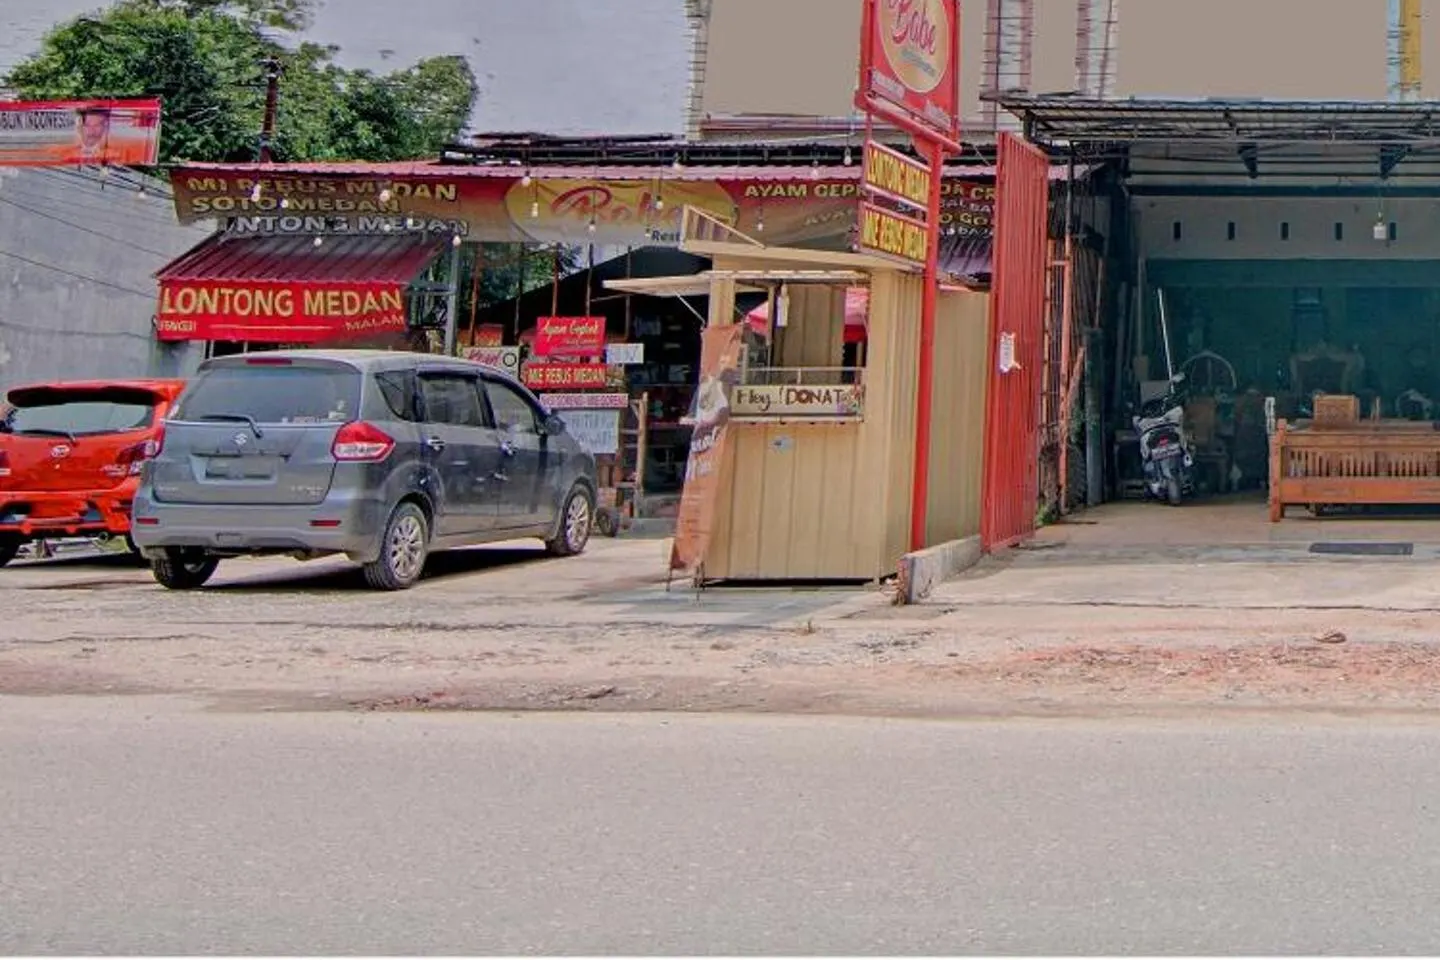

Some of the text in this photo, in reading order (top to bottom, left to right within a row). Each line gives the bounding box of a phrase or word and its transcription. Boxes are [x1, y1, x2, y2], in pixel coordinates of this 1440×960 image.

[745, 185, 808, 197] AYAM
[192, 195, 402, 213] SOTO MEDAN
[161, 287, 403, 316] LONTONG MEDAN
